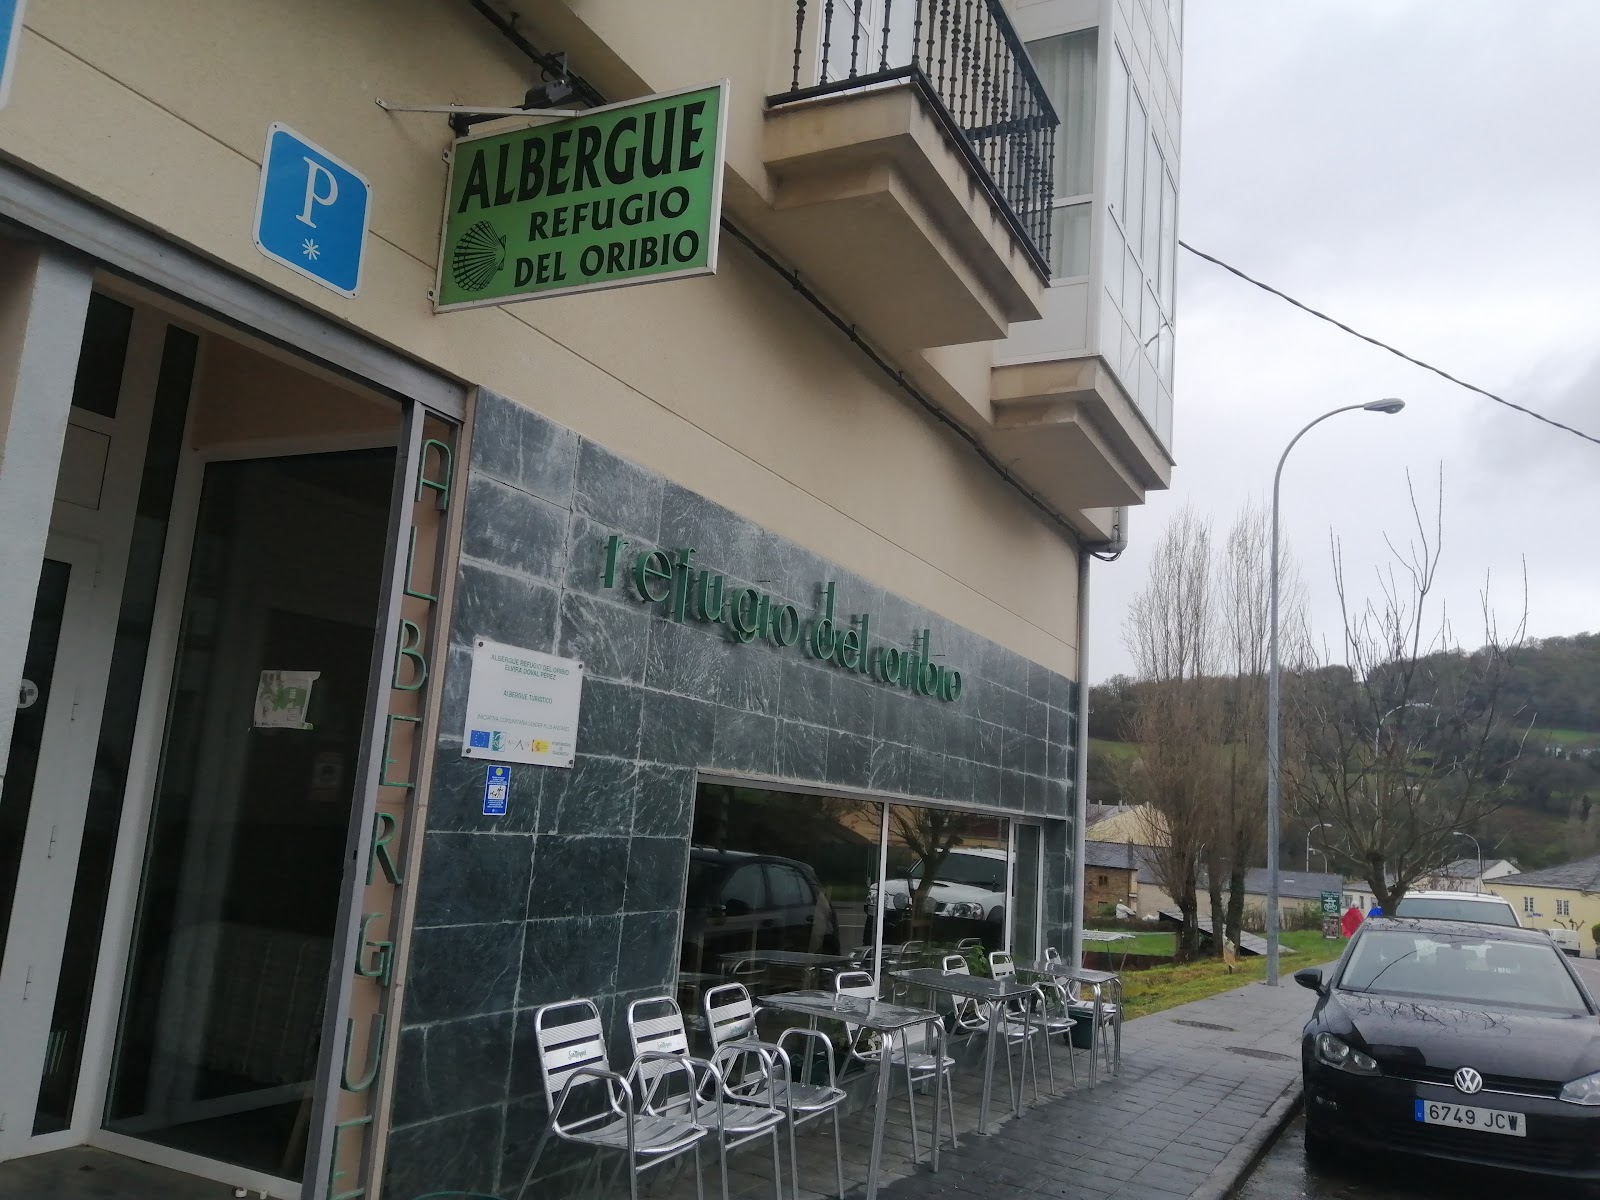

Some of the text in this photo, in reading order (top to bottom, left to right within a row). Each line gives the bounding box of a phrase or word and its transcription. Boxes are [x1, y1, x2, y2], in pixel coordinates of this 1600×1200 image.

[458, 101, 706, 213] ALBERGUE
[295, 156, 339, 229] P
[528, 186, 690, 242] REFUGIO
[514, 229, 699, 288] DEL ORIBIO
[604, 535, 800, 647] refugio
[811, 582, 869, 673] del
[490, 654, 519, 665] ALBERGUE
[520, 660, 542, 670] REFUGIO
[543, 664, 552, 672] DEL
[504, 664, 522, 674] ELVIRA
[503, 689, 528, 701] ALBERGUE
[1429, 1105, 1518, 1131] 6749 JCW
